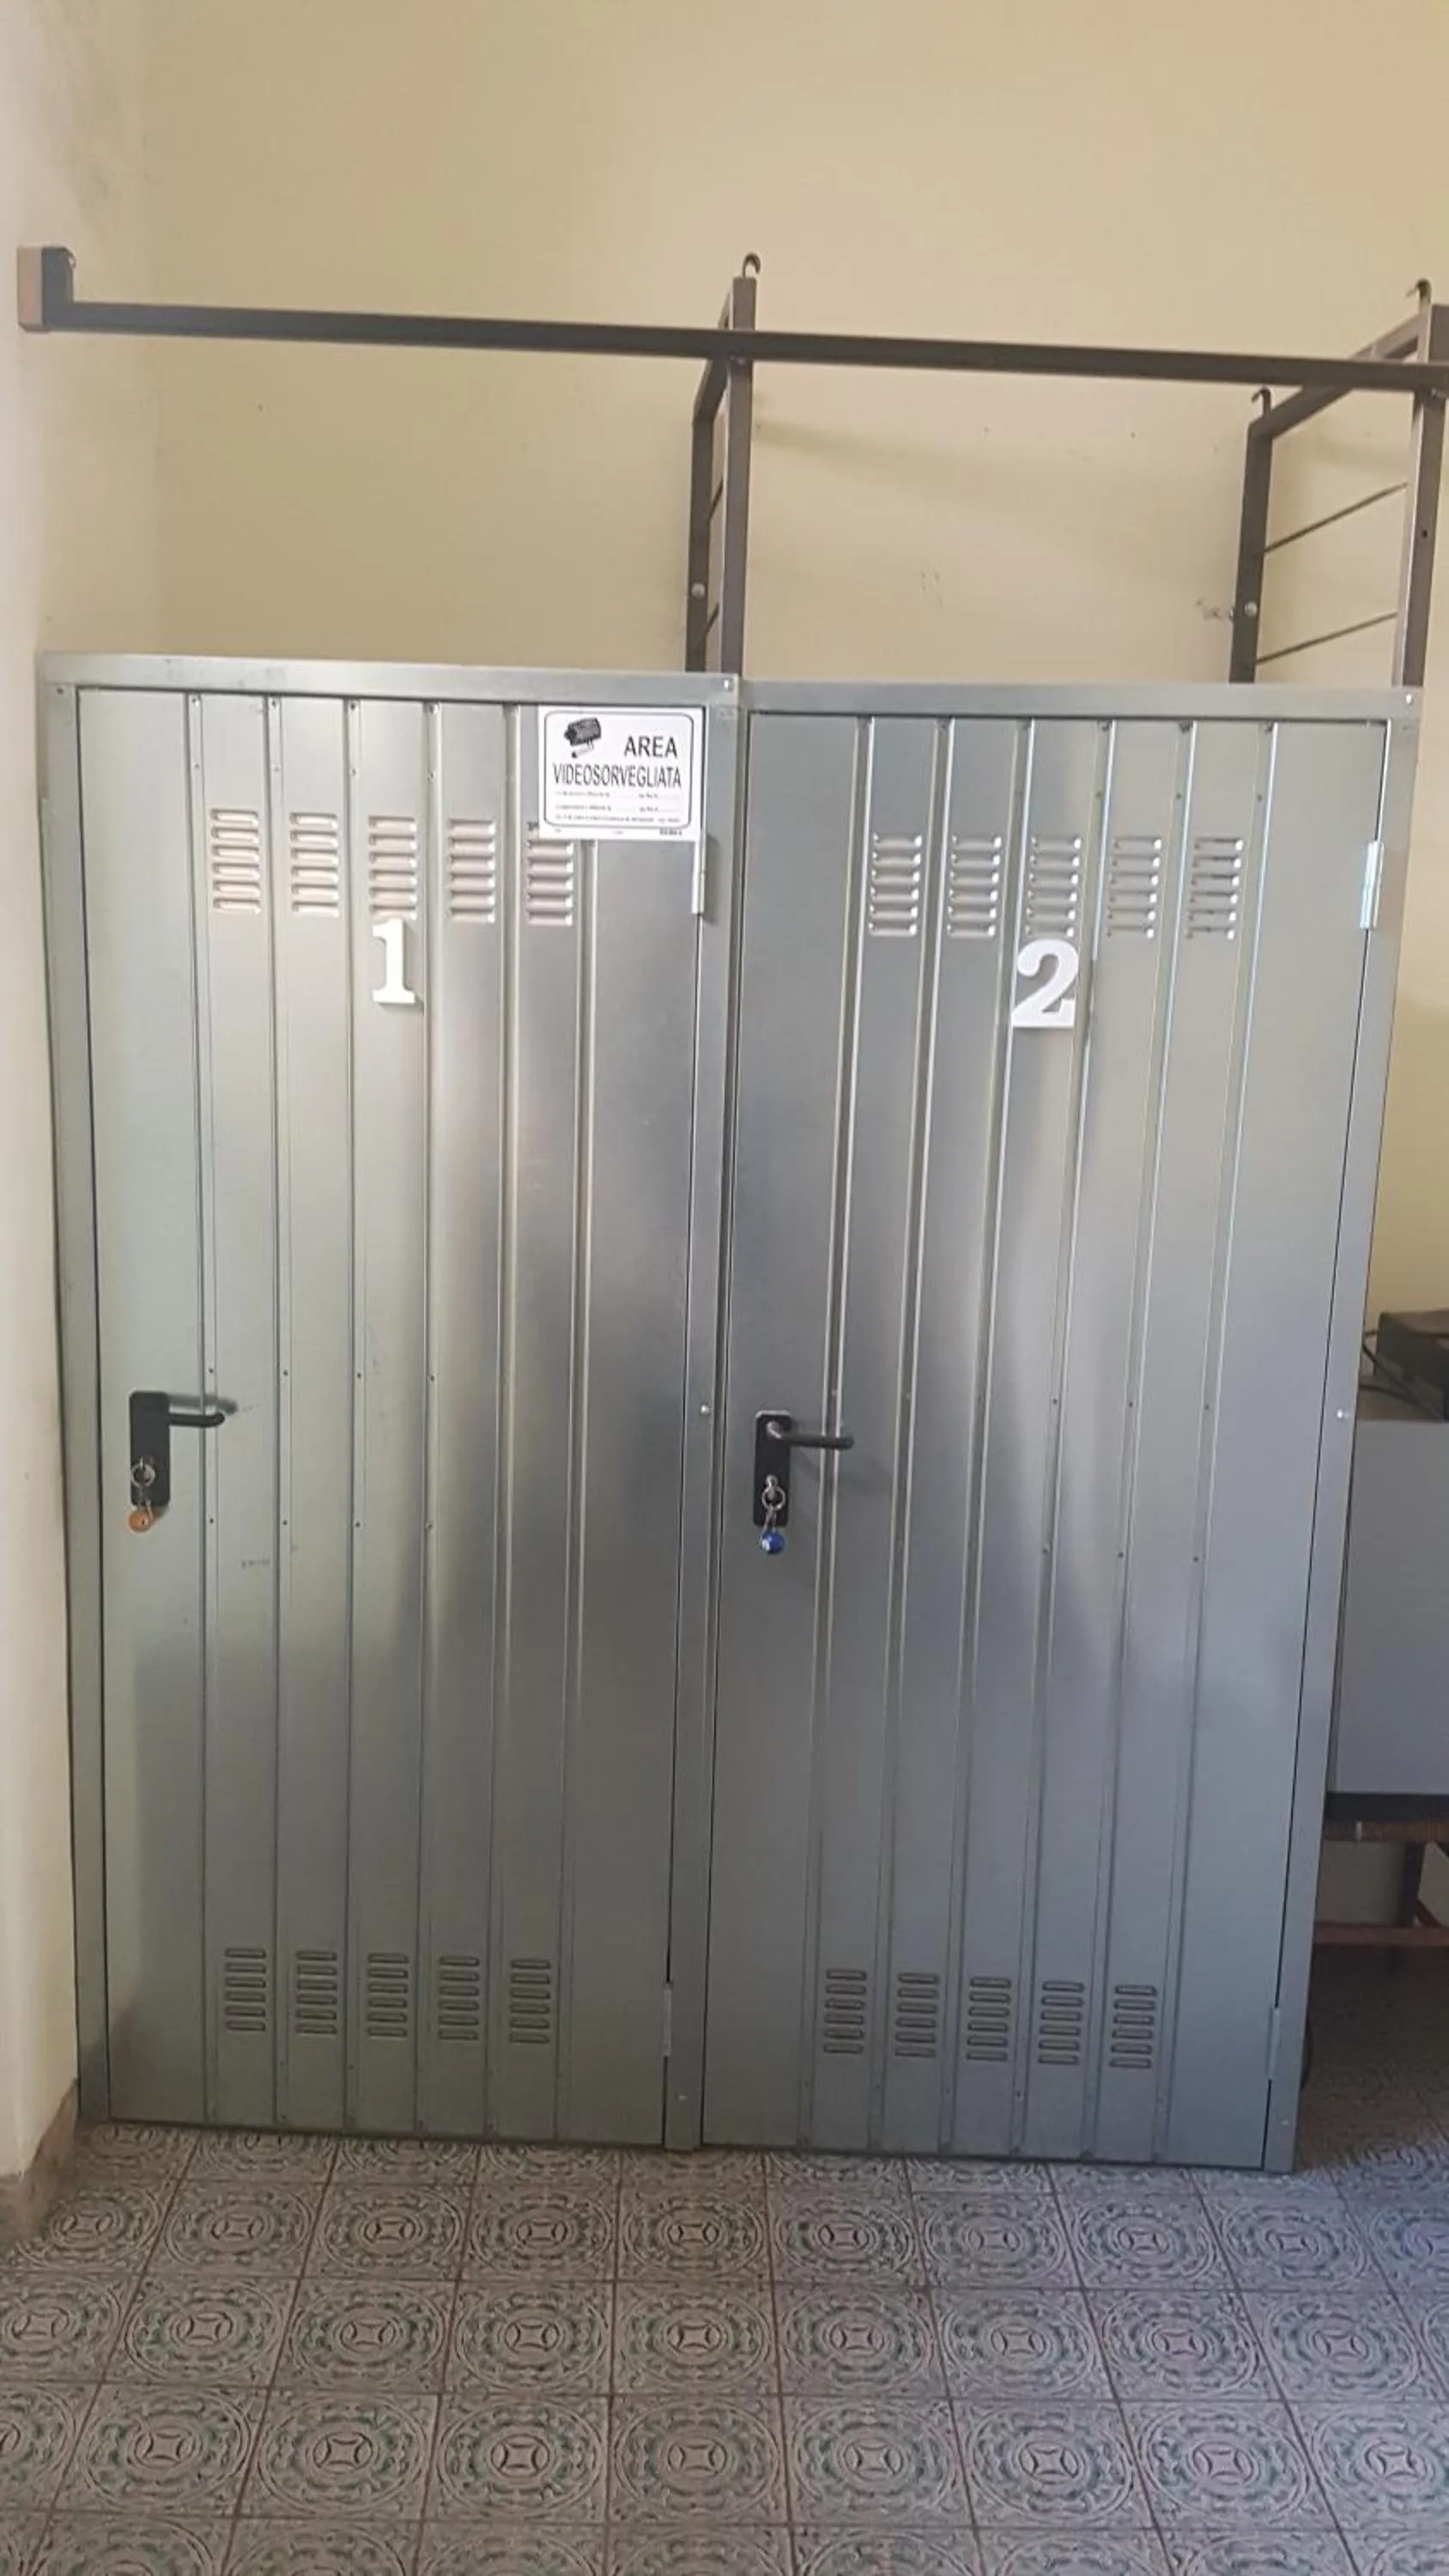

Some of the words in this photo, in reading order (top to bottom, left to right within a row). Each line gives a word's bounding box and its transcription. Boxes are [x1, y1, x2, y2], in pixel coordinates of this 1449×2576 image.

[552, 762, 682, 789] VIDEOSORVEGLIATA
[624, 735, 678, 759] AREA
[372, 917, 415, 1004] 1
[1011, 939, 1078, 1028] 2
